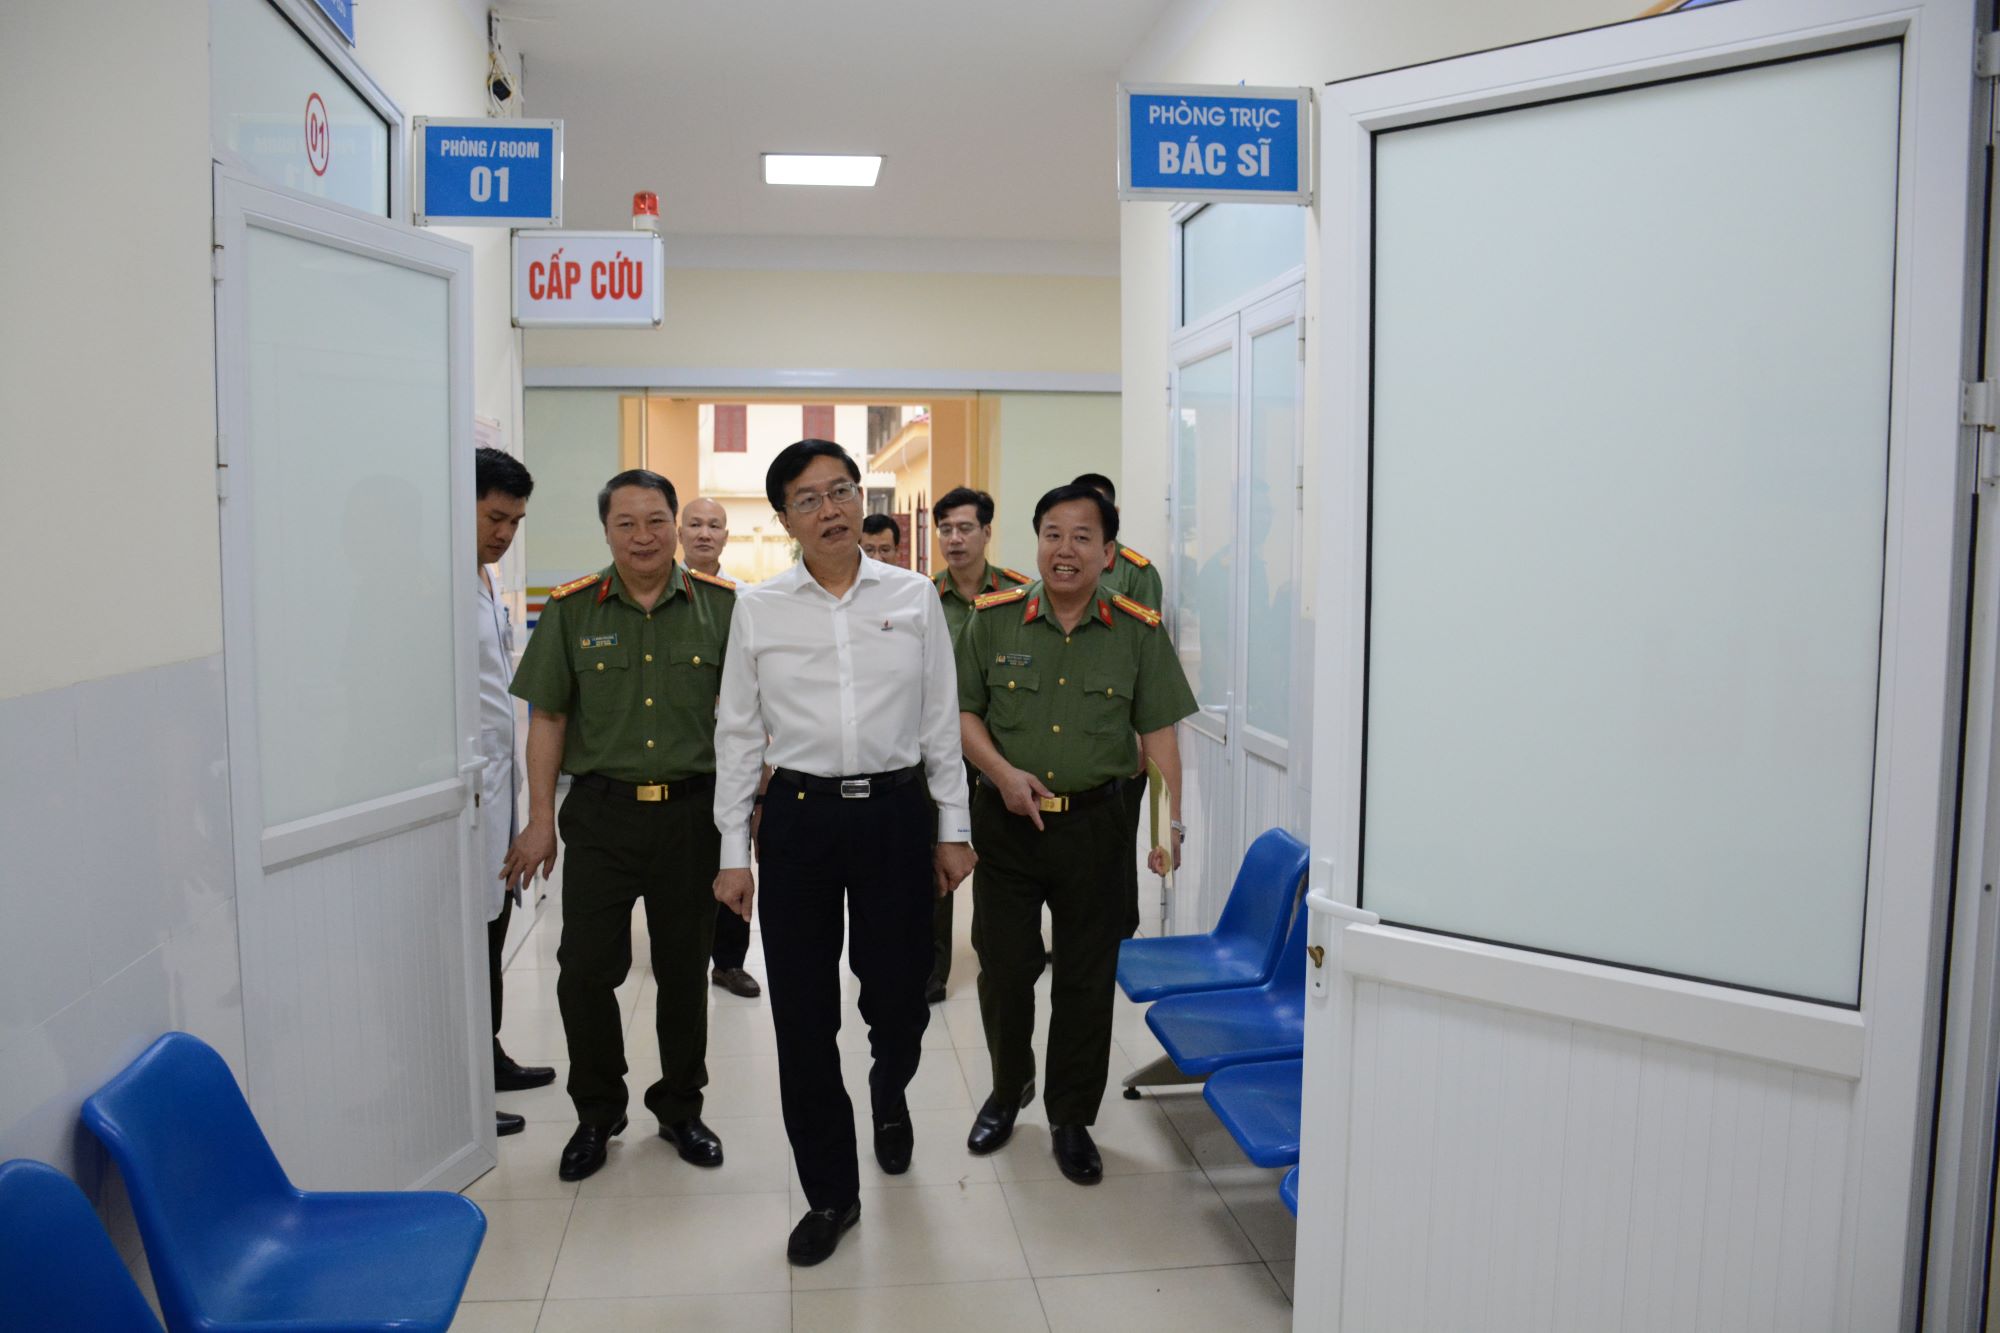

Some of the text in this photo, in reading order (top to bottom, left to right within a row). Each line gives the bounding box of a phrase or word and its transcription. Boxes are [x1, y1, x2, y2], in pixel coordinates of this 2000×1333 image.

[310, 112, 325, 159] 01
[1149, 100, 1281, 132] PHÒNG TRỰC
[440, 137, 487, 158] PHÒNG
[499, 141, 540, 158] ROOM
[1158, 136, 1271, 177] BÁC SĨ
[469, 166, 509, 203] 01
[529, 248, 643, 301] CẤP CỨU
